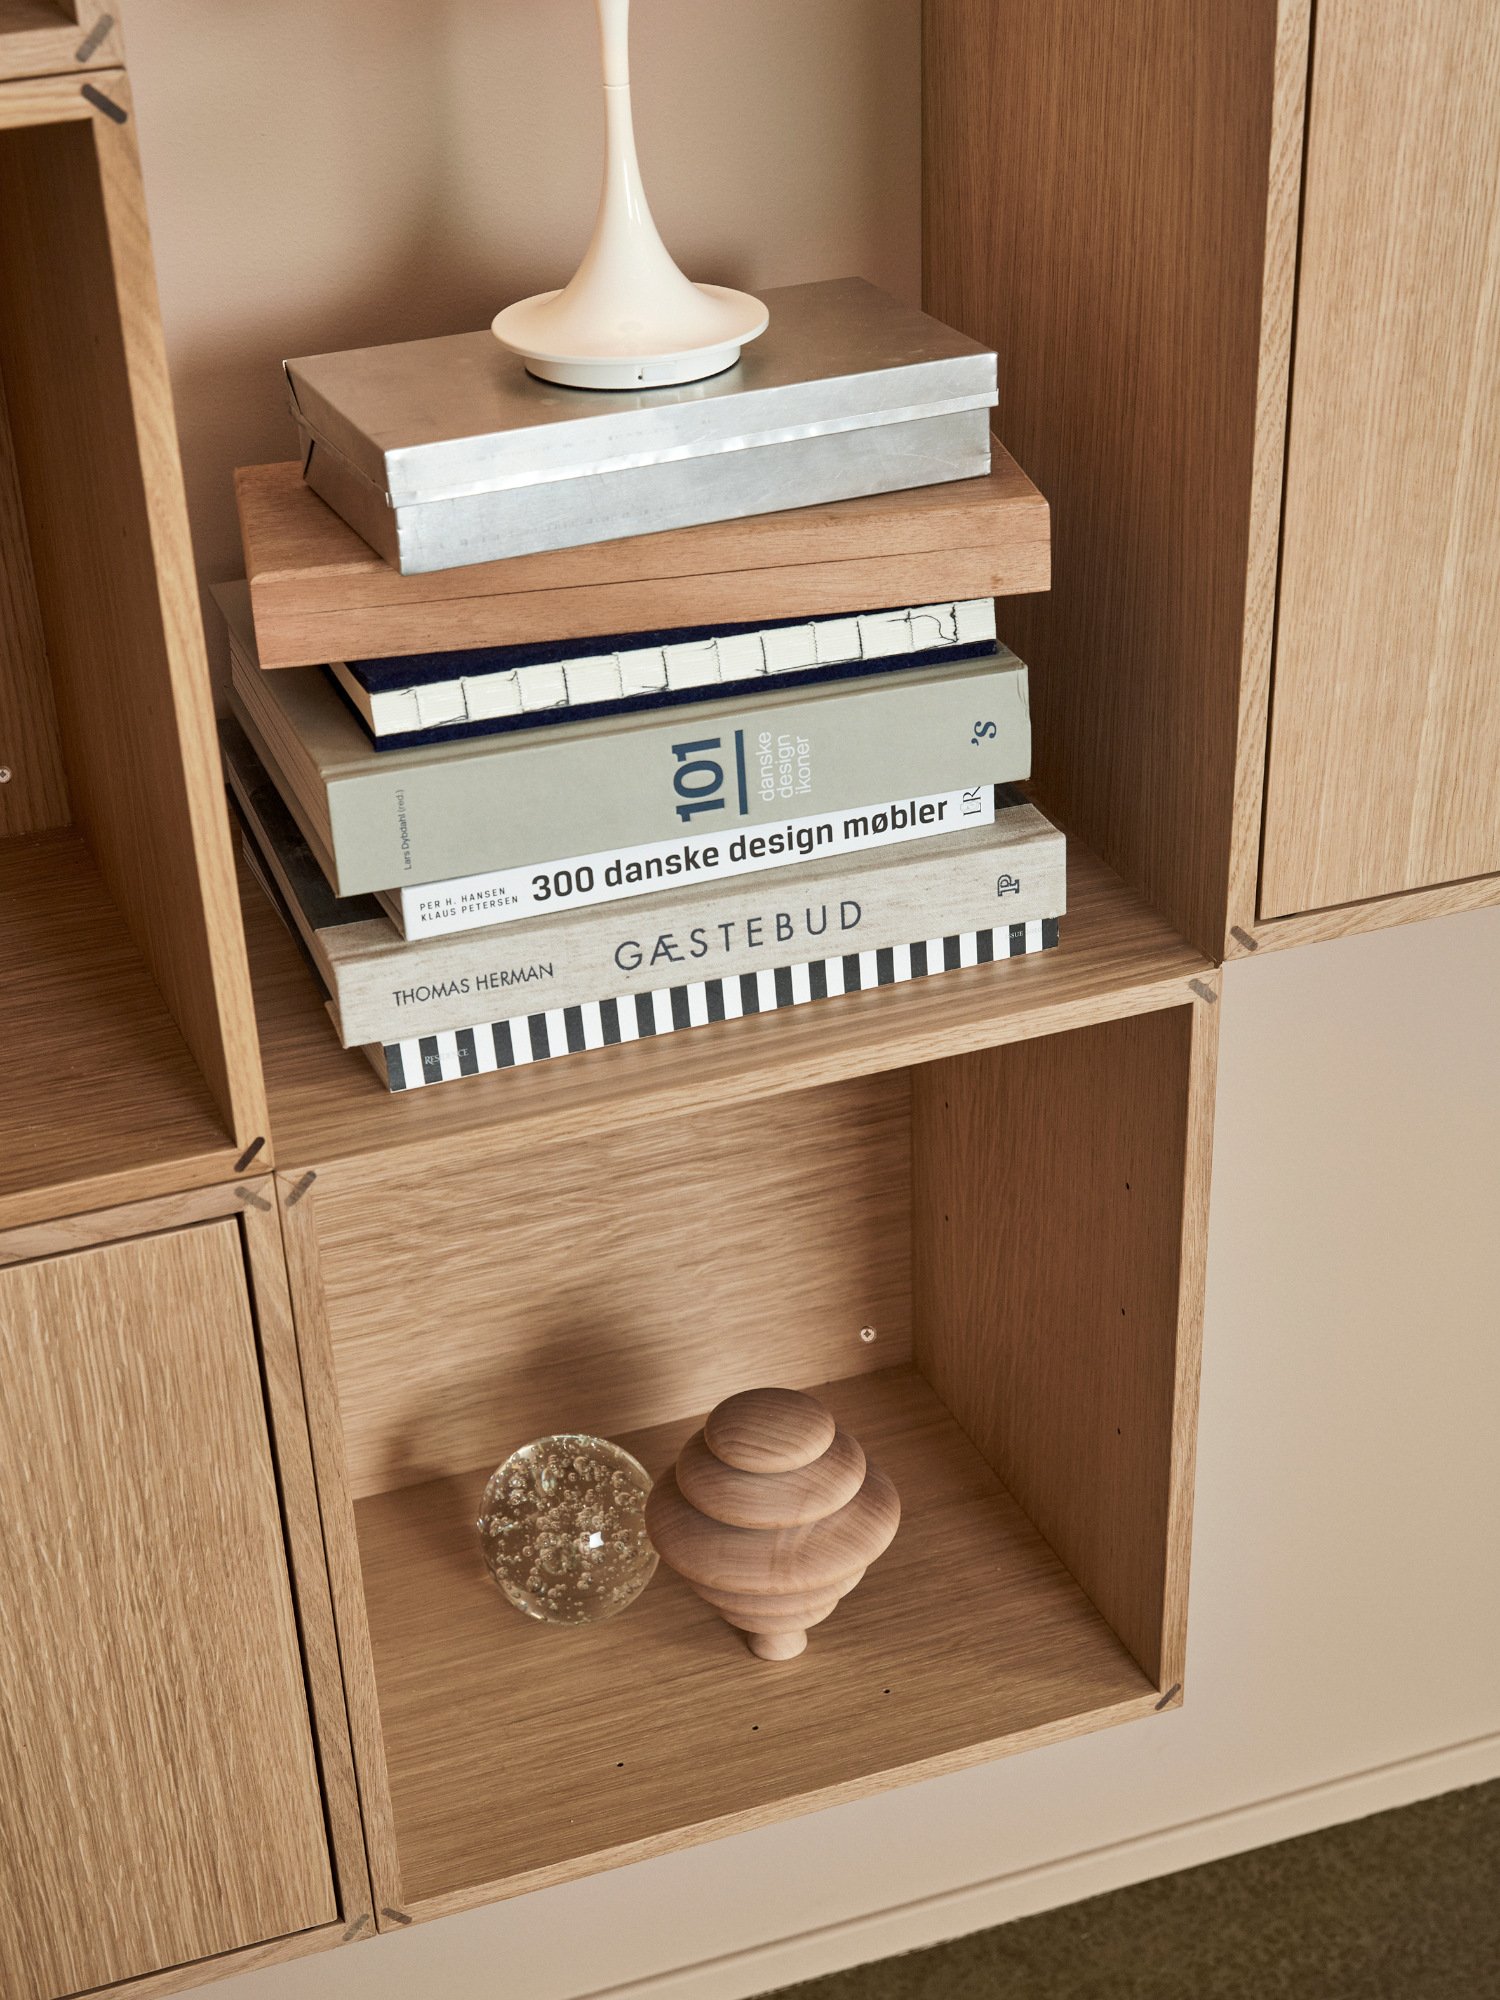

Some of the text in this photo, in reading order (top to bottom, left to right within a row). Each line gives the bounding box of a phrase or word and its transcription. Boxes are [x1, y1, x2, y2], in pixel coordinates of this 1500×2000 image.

[672, 738, 725, 823] 101
[755, 731, 775, 802] danske
[775, 734, 795, 799] design
[795, 736, 812, 795] ikoner
[395, 789, 412, 870] Lars Dybdahl (red.)
[532, 798, 948, 901] 300 danske design møbler
[420, 887, 506, 911] PER H. HANSEN
[421, 895, 519, 922] KLAUS PETERSEN
[997, 873, 1020, 897] P
[614, 900, 862, 971] GÆSTEBUD
[392, 962, 554, 1007] THOMAS HERMAN
